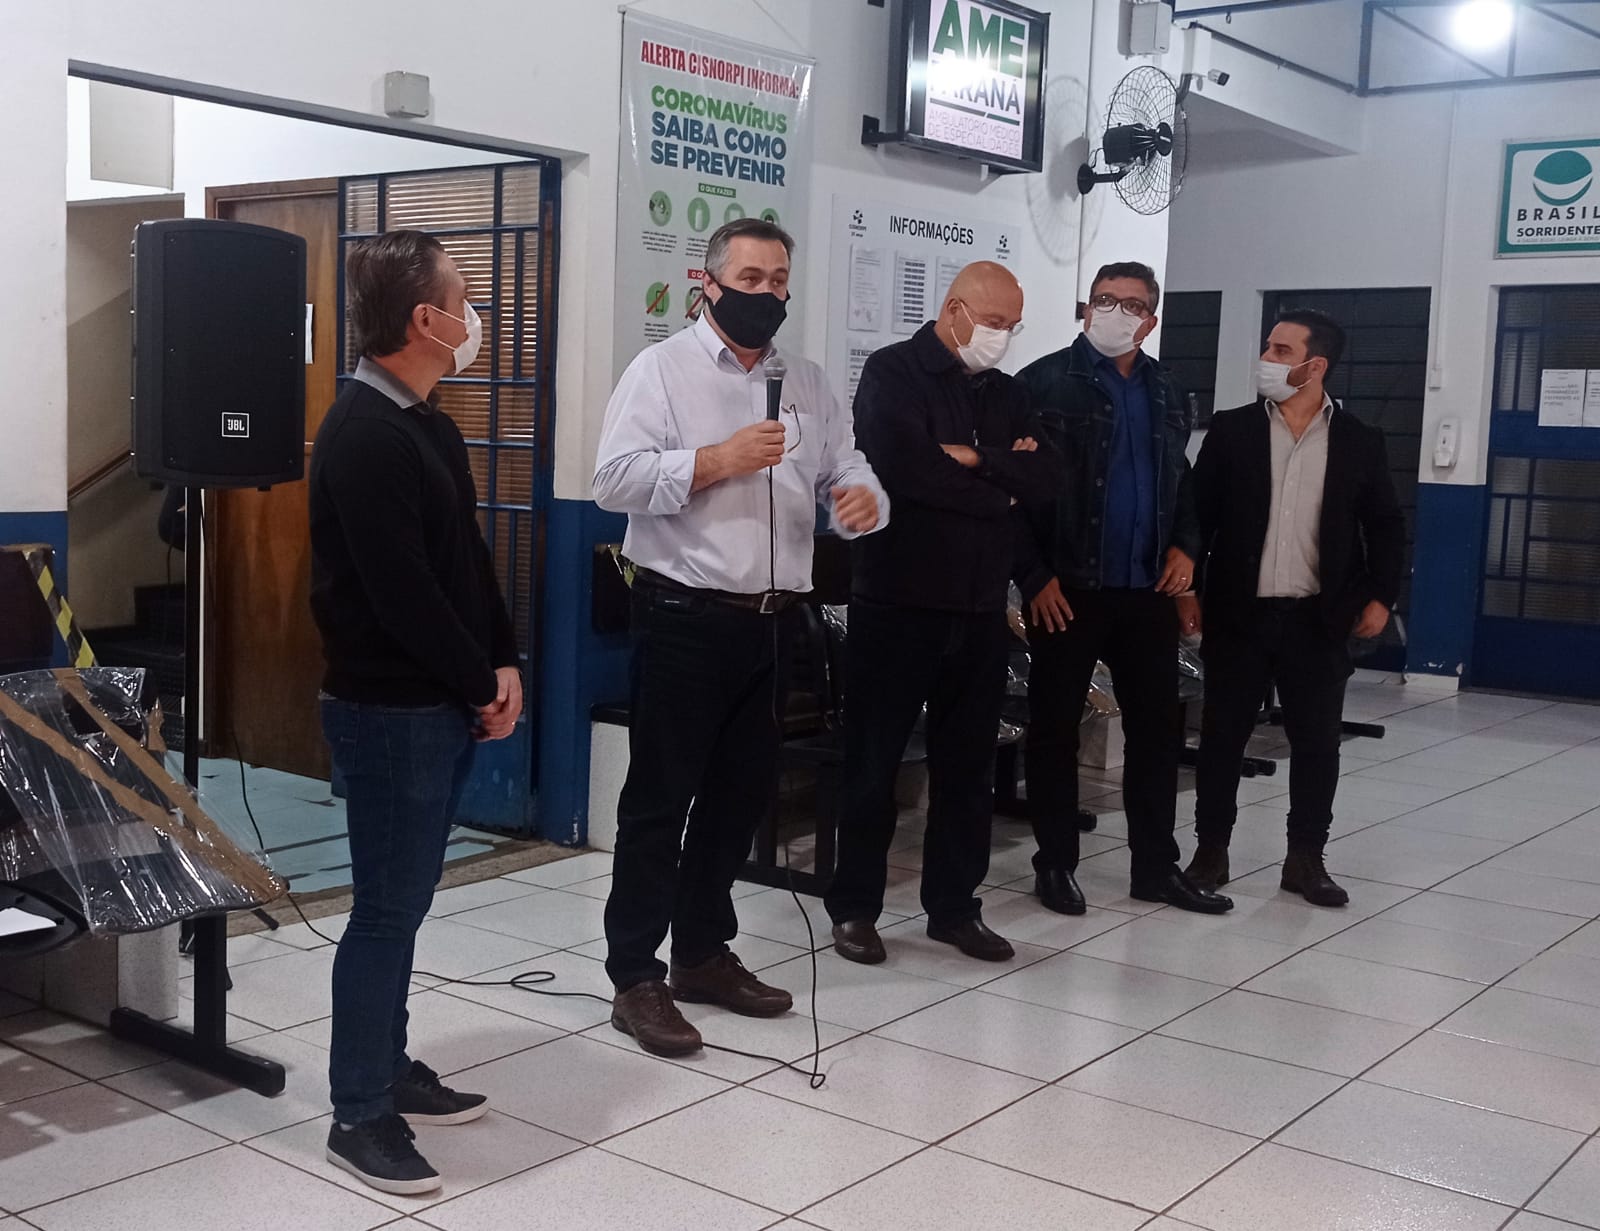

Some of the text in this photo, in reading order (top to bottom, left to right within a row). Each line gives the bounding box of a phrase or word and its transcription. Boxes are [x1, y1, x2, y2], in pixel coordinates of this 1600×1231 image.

[933, 0, 1026, 79] AME
[641, 40, 686, 72] ALERTA
[688, 52, 744, 86] CISNORPI
[651, 84, 787, 134] CORONAVÍRUS
[651, 111, 787, 160] SAIBA COMO
[651, 139, 786, 187] SE PREVENIR
[890, 214, 975, 246] INFORMAÇÕES
[1517, 205, 1600, 221] BRASIL
[1517, 225, 1600, 238] SORRIDENTE
[227, 418, 245, 431] JBL
